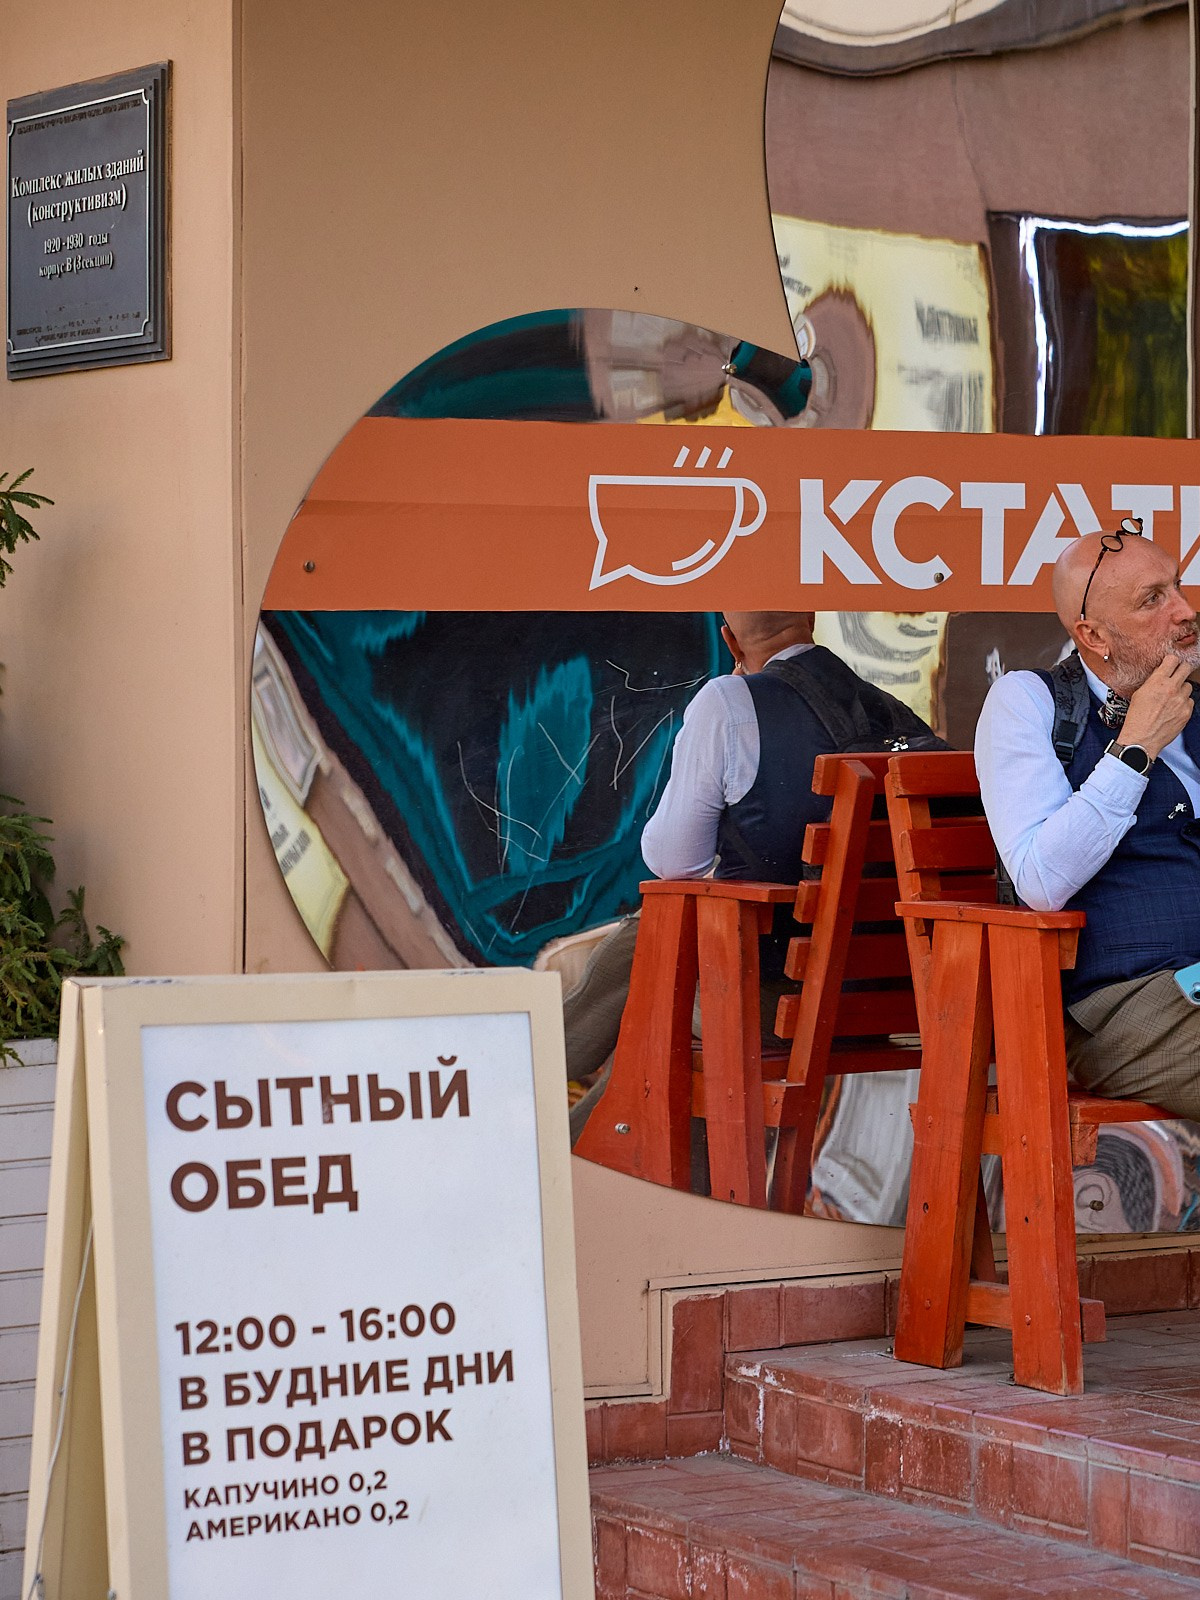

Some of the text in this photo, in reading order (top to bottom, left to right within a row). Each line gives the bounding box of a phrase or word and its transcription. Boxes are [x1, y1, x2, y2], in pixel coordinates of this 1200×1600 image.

[11, 149, 144, 198] Комплекс жилых зданий
[27, 182, 126, 228] (конструктивизм)
[44, 237, 61, 254] 1920
[88, 232, 109, 246] годы
[39, 263, 65, 279] корпус
[165, 1055, 471, 1132] СЫТНЫЙ
[170, 1153, 359, 1215] ОБЕД
[175, 1314, 296, 1356] 12:00
[340, 1302, 457, 1343] 16:00
[179, 1350, 516, 1411] В БУДНИЕ ДНИ
[182, 1409, 453, 1466] В ПОДАРОК
[184, 1470, 388, 1509] КАПУЧИНО 0,2
[185, 1500, 410, 1542] АМЕРИКАНО 0,2
